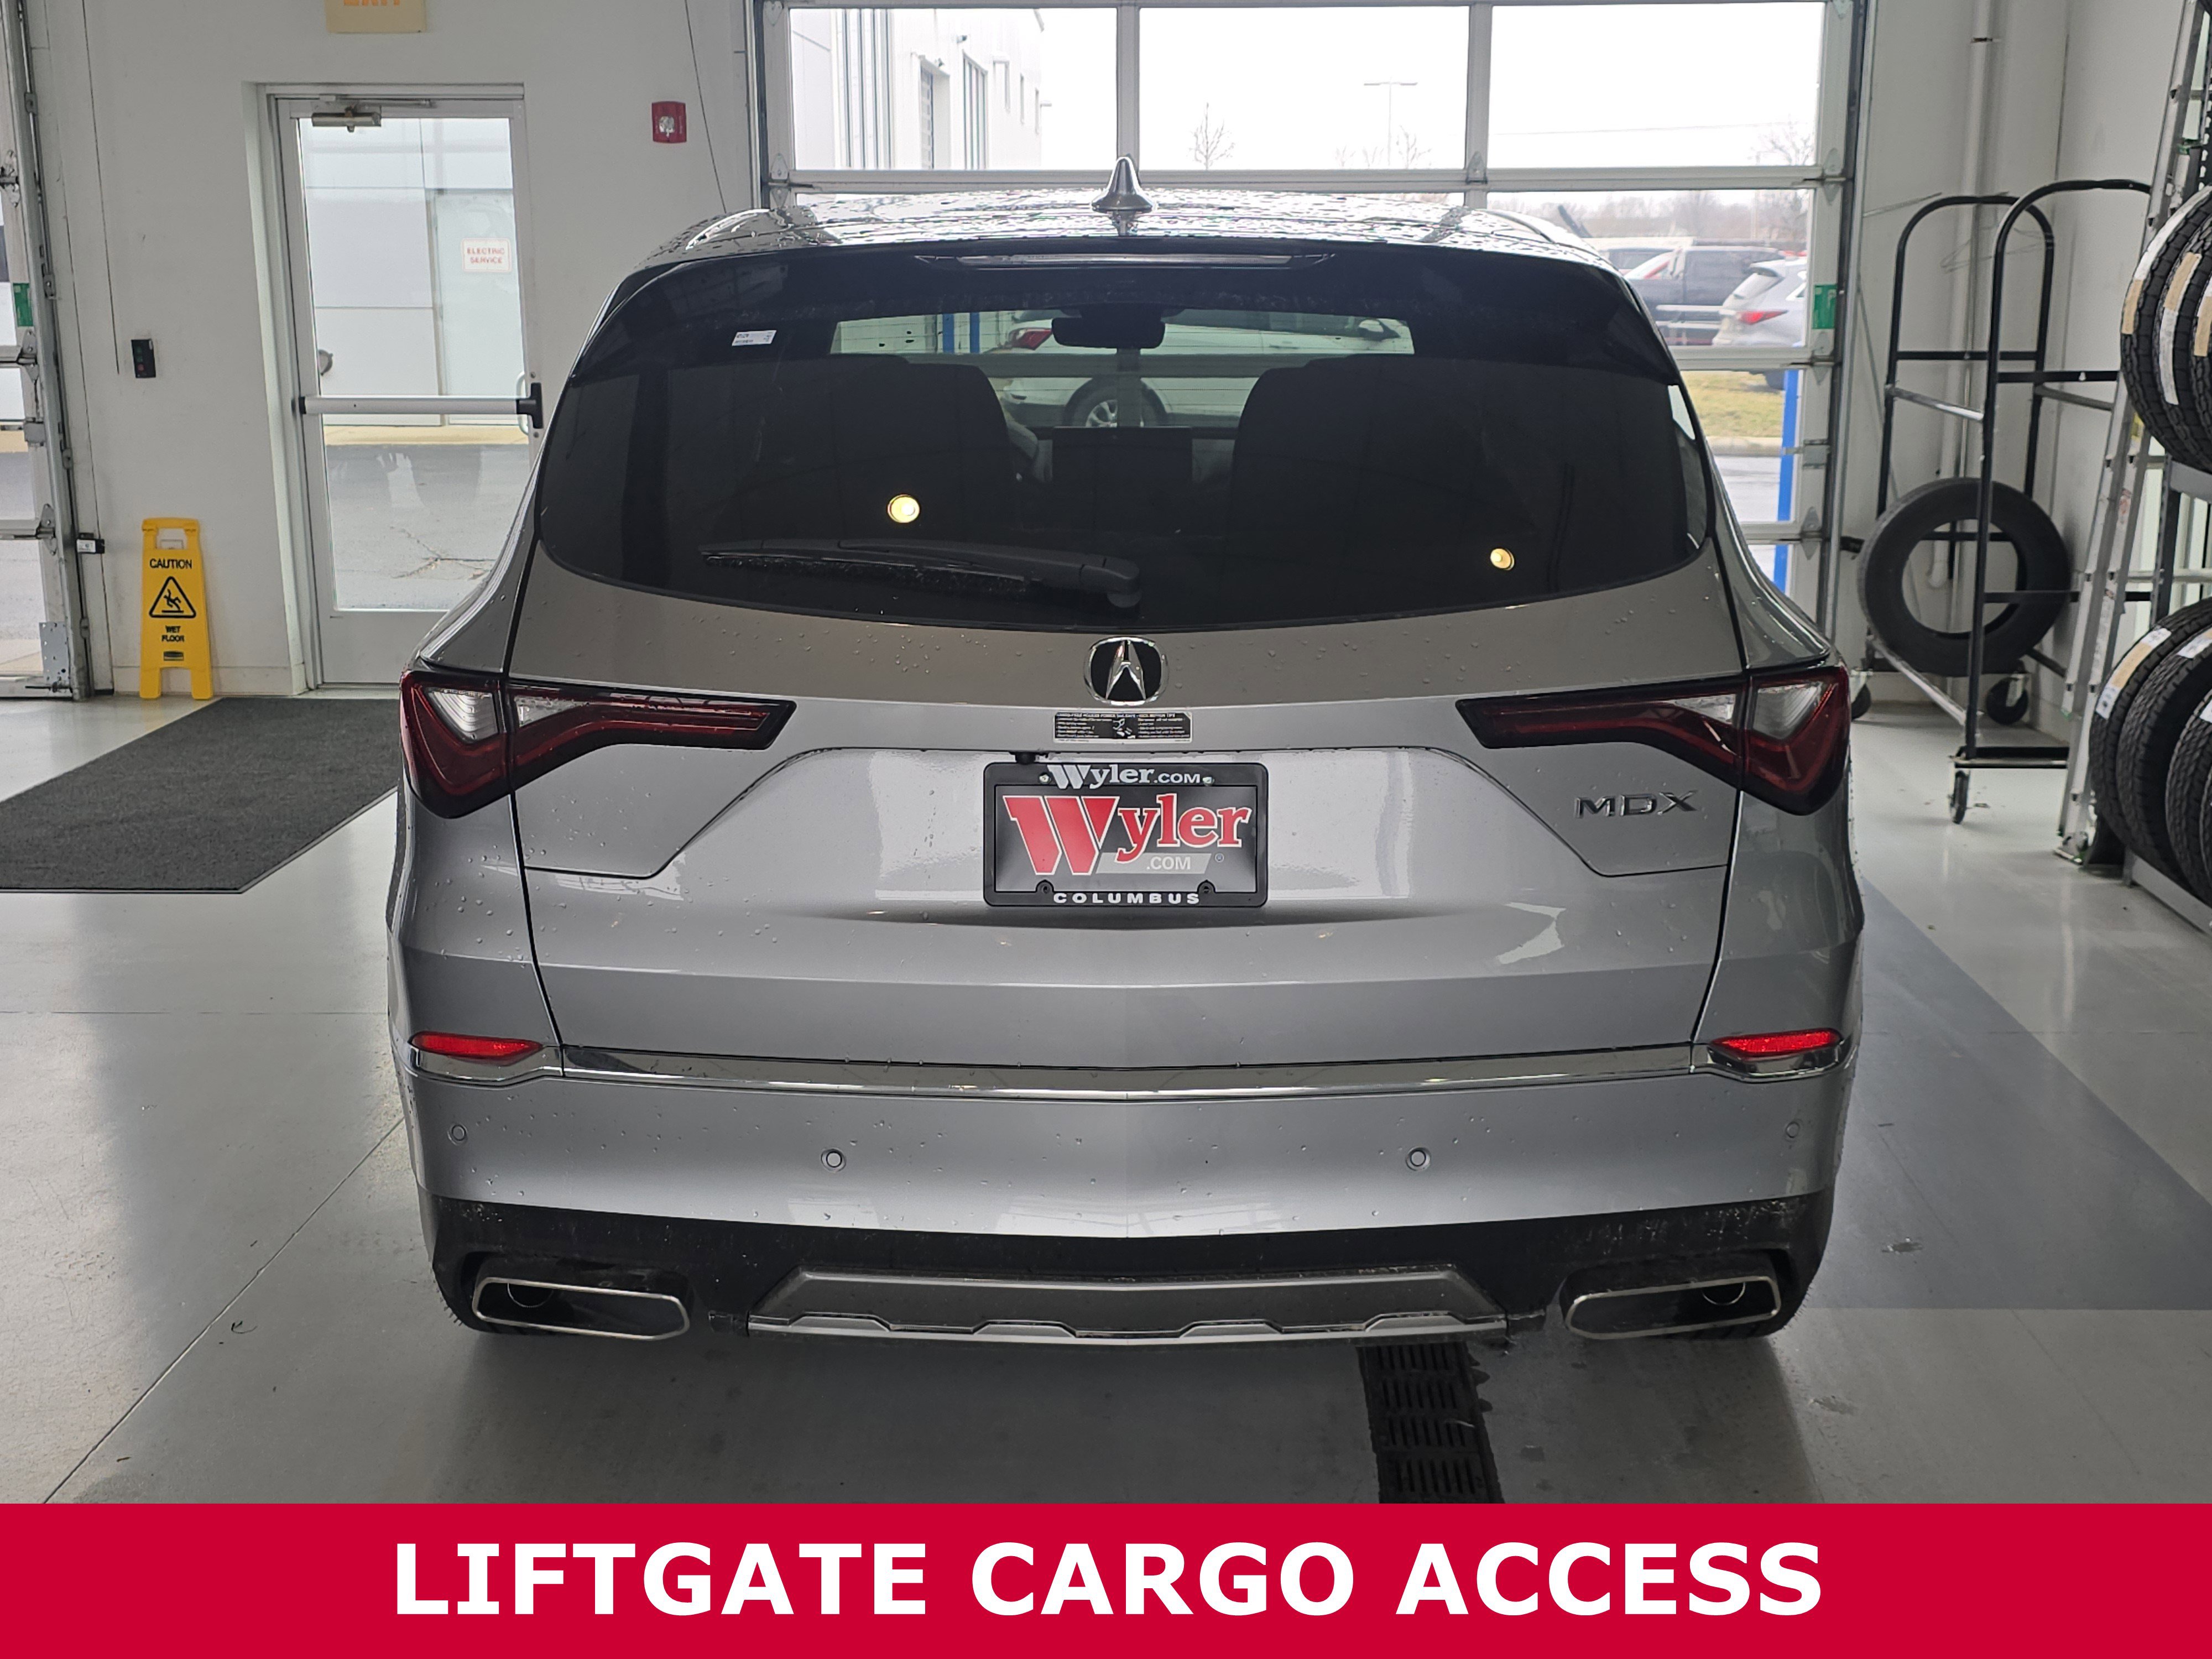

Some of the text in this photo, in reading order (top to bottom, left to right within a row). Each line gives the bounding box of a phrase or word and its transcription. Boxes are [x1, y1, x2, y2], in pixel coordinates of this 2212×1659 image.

[150, 559, 192, 569] CAUTION
[1575, 791, 1697, 818] MDX
[1001, 793, 1252, 875] Wyler
[1053, 893, 1200, 905] COLUMBUS
